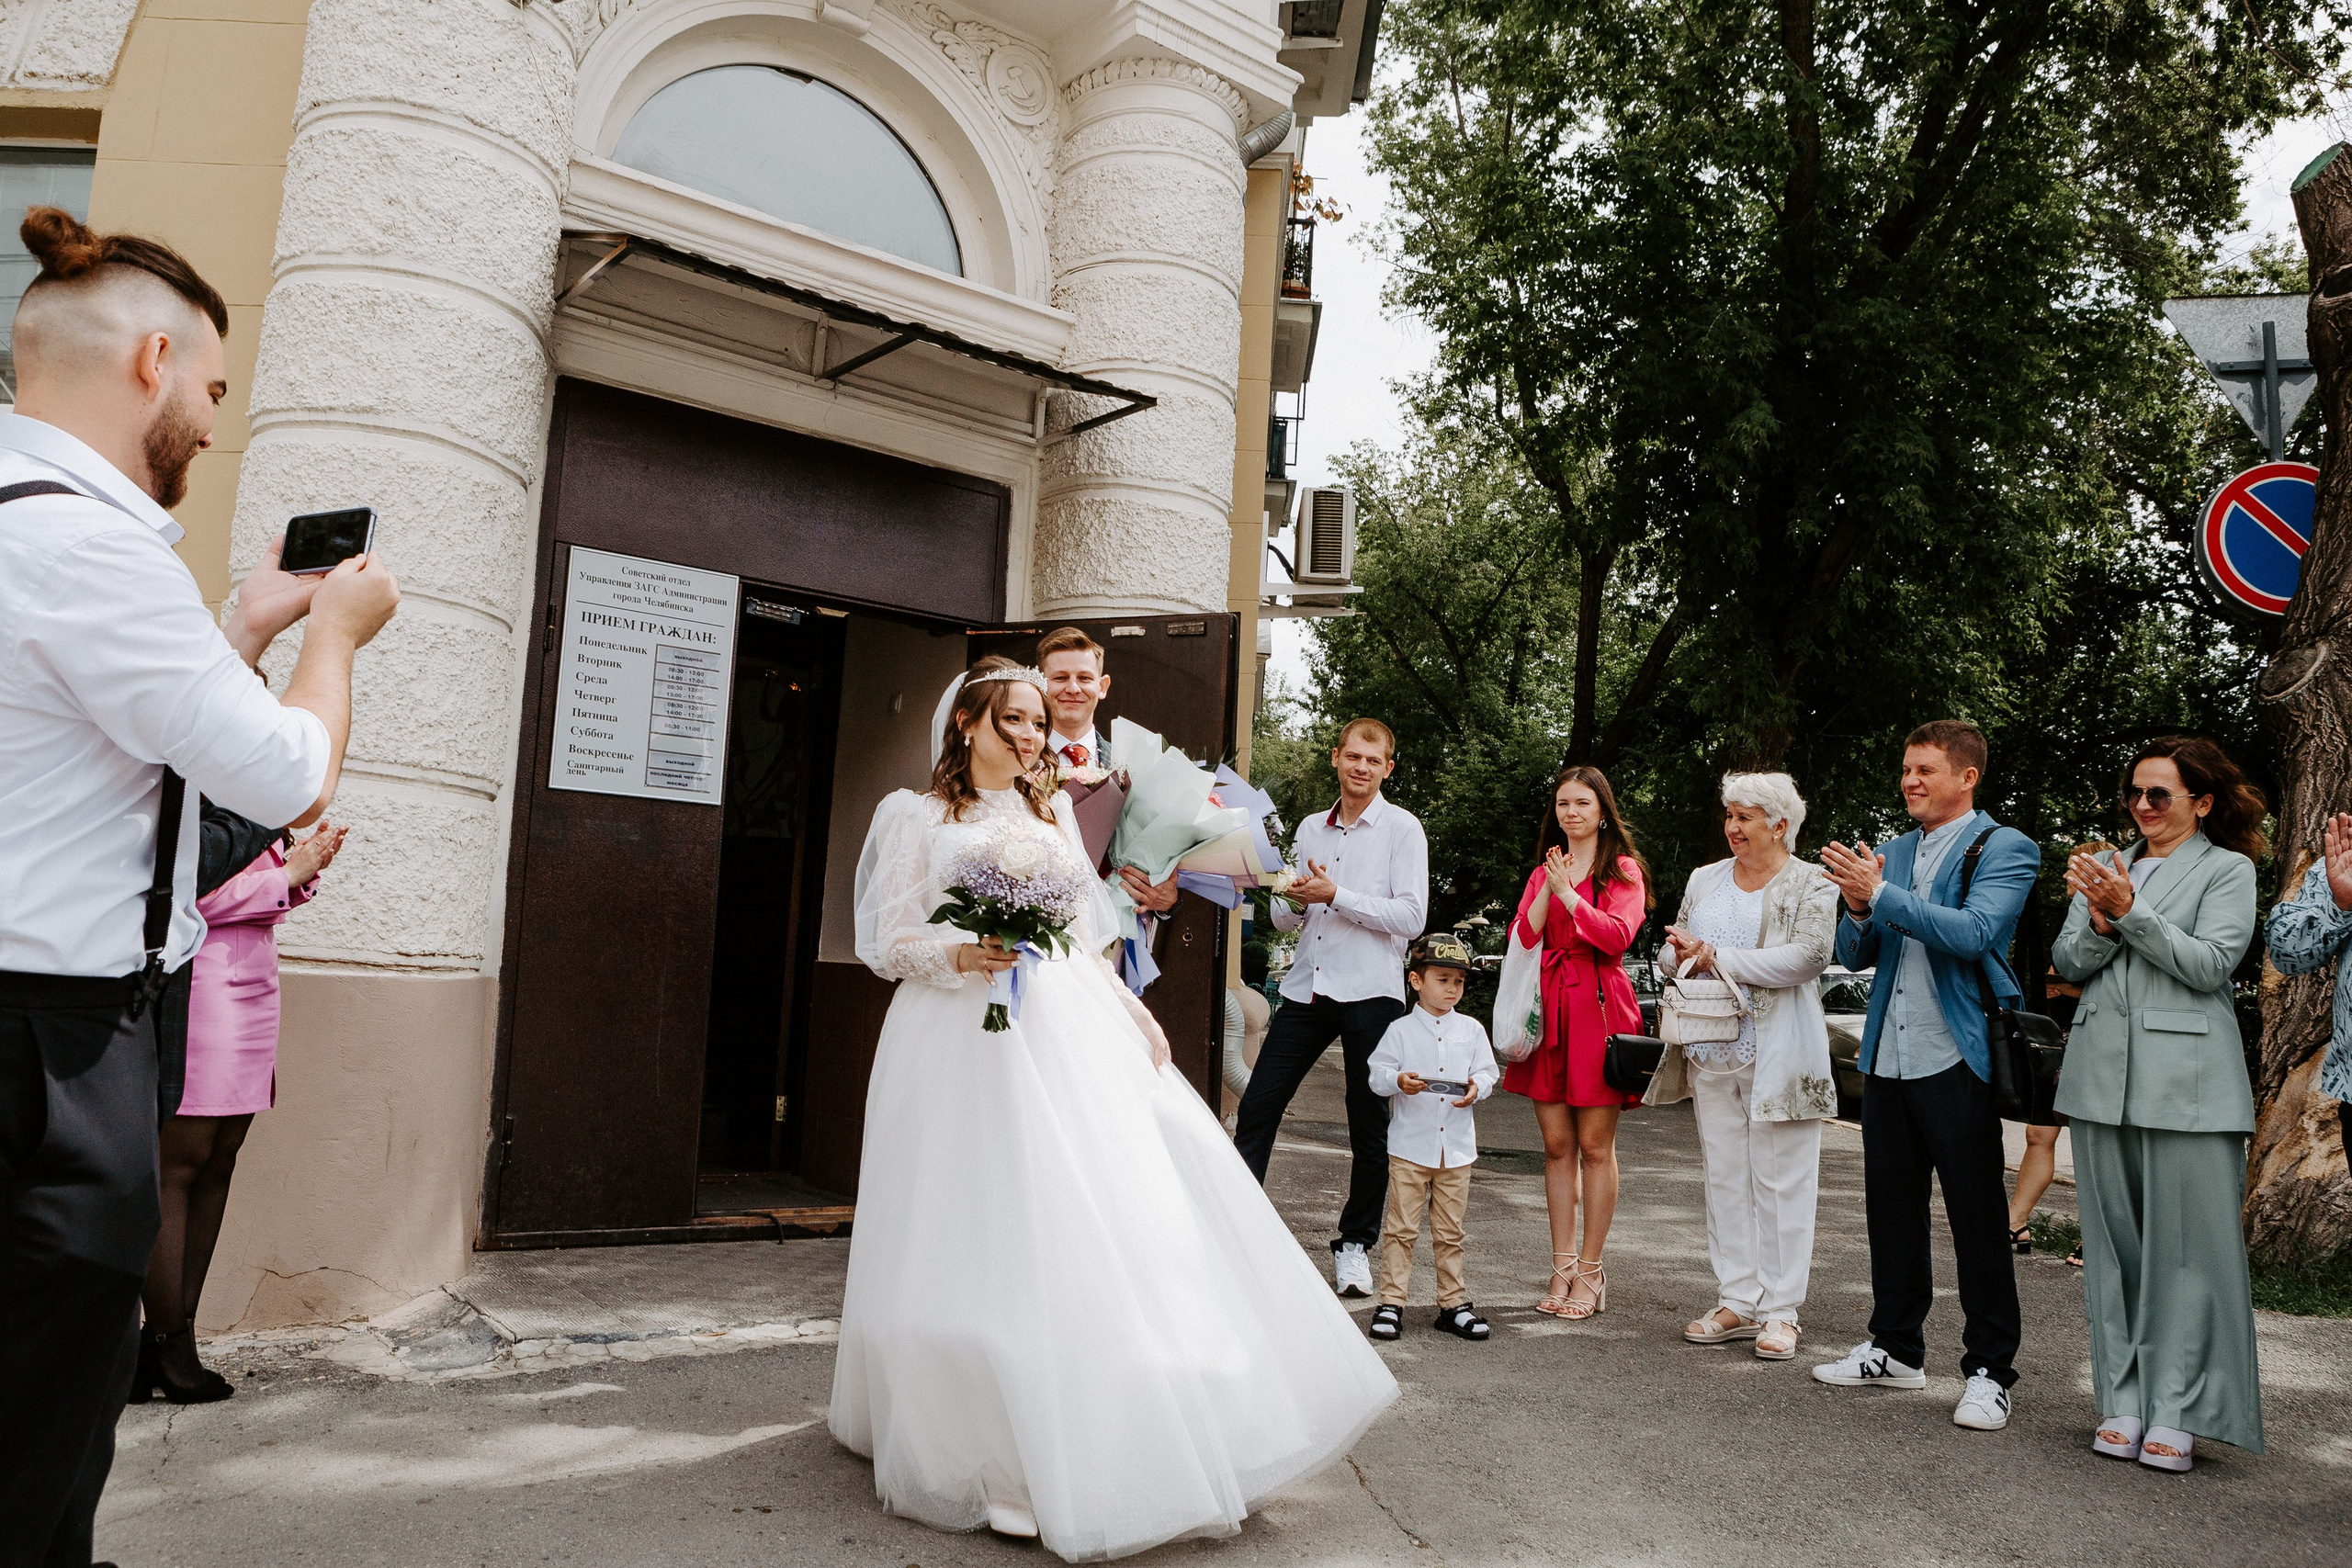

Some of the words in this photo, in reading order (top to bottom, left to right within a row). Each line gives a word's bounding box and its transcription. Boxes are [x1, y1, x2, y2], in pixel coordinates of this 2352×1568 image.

[621, 566, 666, 582] Советский
[669, 577, 691, 587] отдел
[579, 571, 632, 589] Управления
[634, 581, 660, 593] ЗАГС
[662, 588, 728, 606] Администрации
[613, 592, 641, 604] города
[644, 597, 694, 613] Челябинска
[581, 611, 635, 630] ПРИЕМ
[639, 621, 717, 644] ГРАЖДАН:
[579, 636, 648, 655] Понедельник
[577, 653, 623, 669] Вторник
[576, 671, 607, 684] Среда
[574, 689, 616, 705] Четверг
[572, 707, 617, 722] Пятница
[571, 726, 614, 739] Суббота
[569, 744, 634, 761] Воскресенье
[567, 760, 624, 773] Санитарный
[1859, 1355, 1895, 1378] AX
